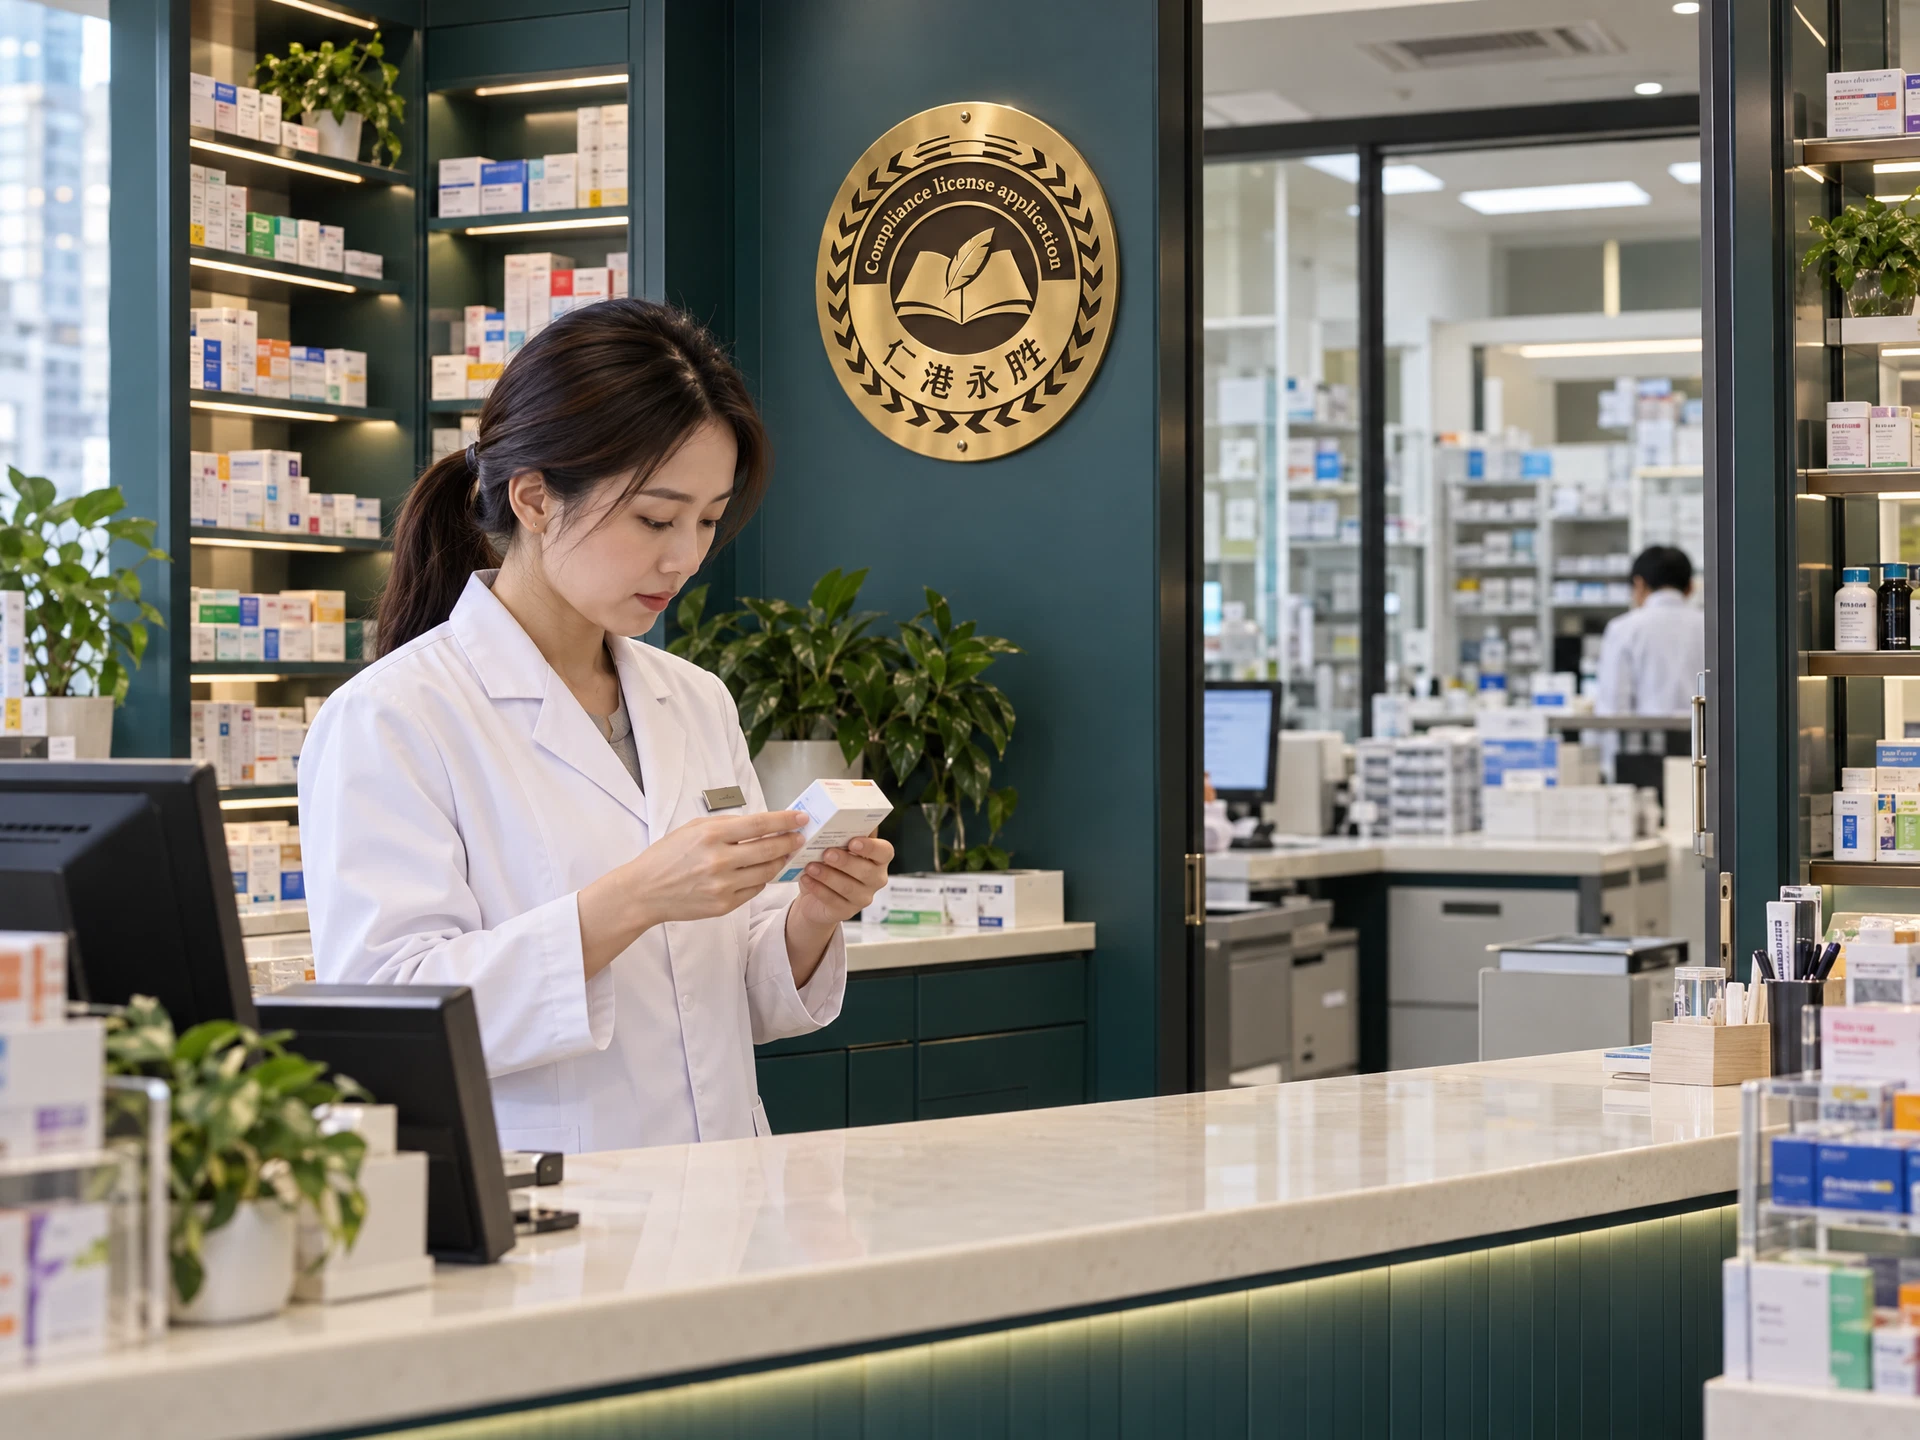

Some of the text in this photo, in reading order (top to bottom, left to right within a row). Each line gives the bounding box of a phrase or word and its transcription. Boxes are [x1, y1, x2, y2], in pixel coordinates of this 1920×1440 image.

[865, 176, 1062, 275] Compliance license application
[882, 337, 1047, 400] 仁港永胜
